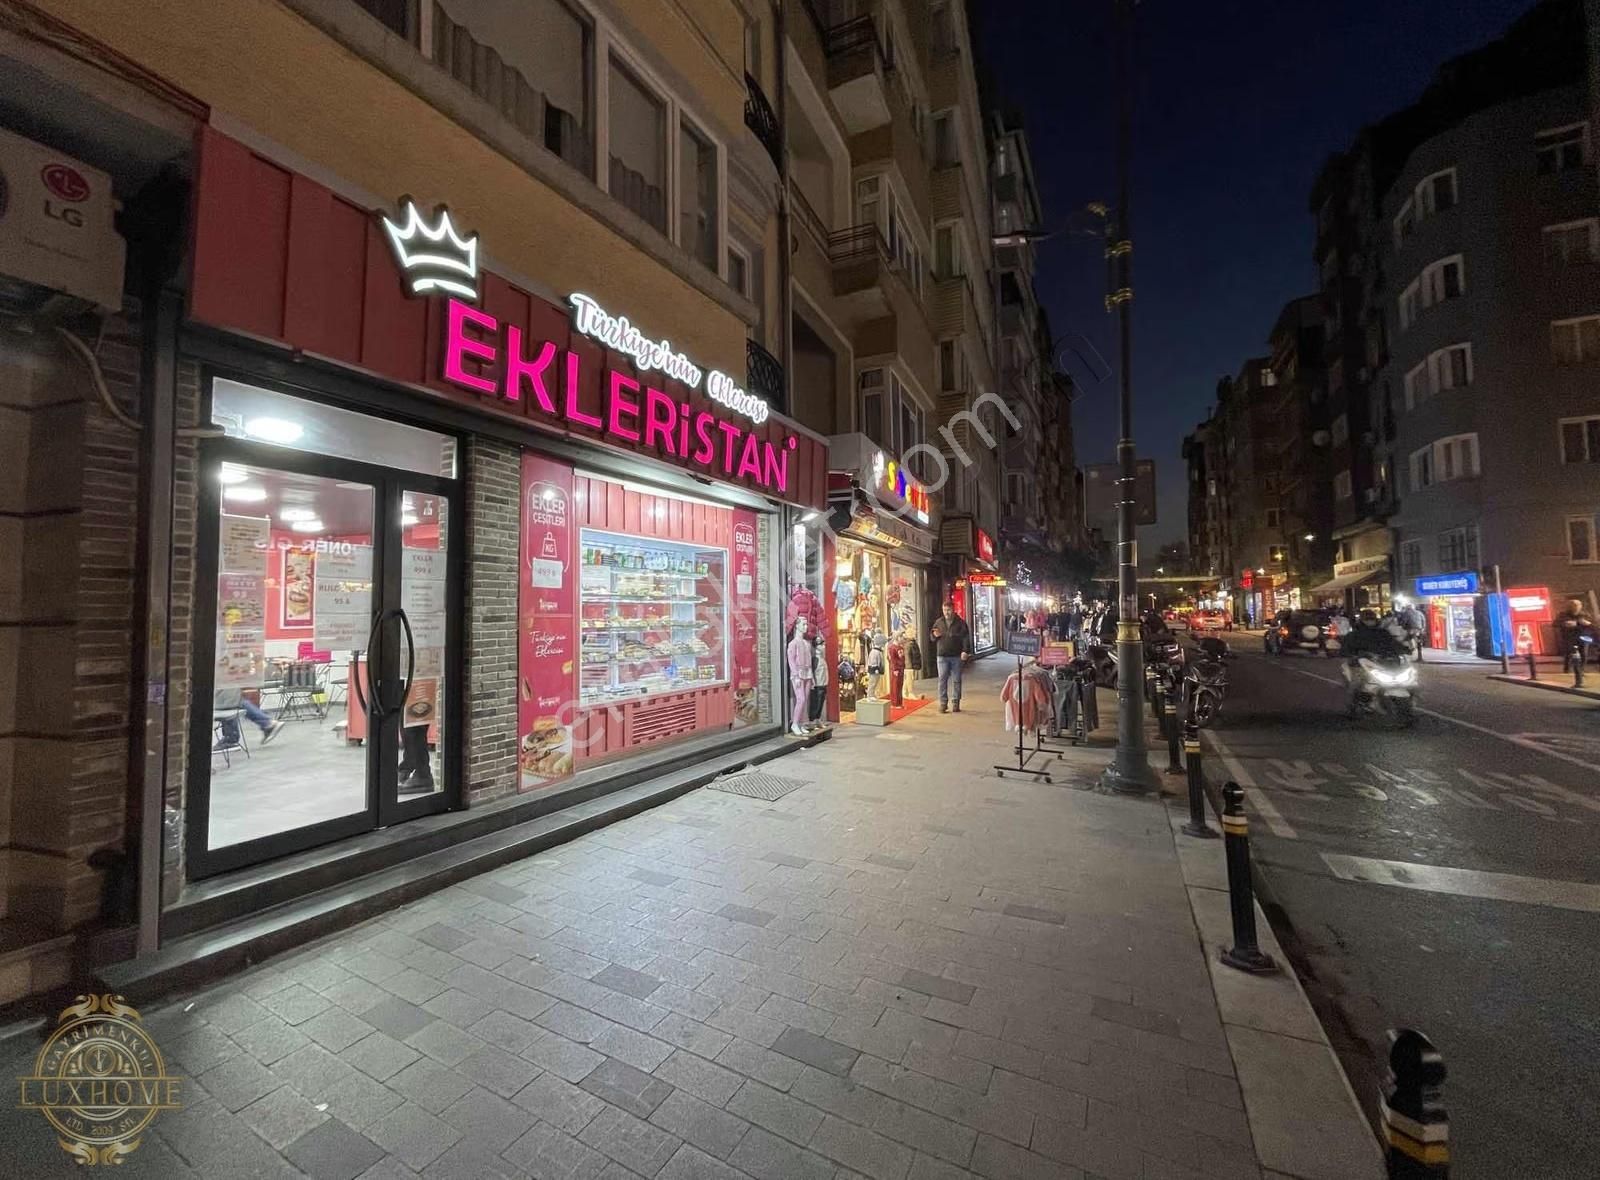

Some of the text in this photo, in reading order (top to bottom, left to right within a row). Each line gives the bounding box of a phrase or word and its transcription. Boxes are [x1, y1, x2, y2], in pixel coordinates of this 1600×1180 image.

[43, 199, 84, 228] LG
[569, 293, 702, 389] Türkiye'nin
[532, 494, 565, 515] EKLER
[544, 543, 555, 553] KG
